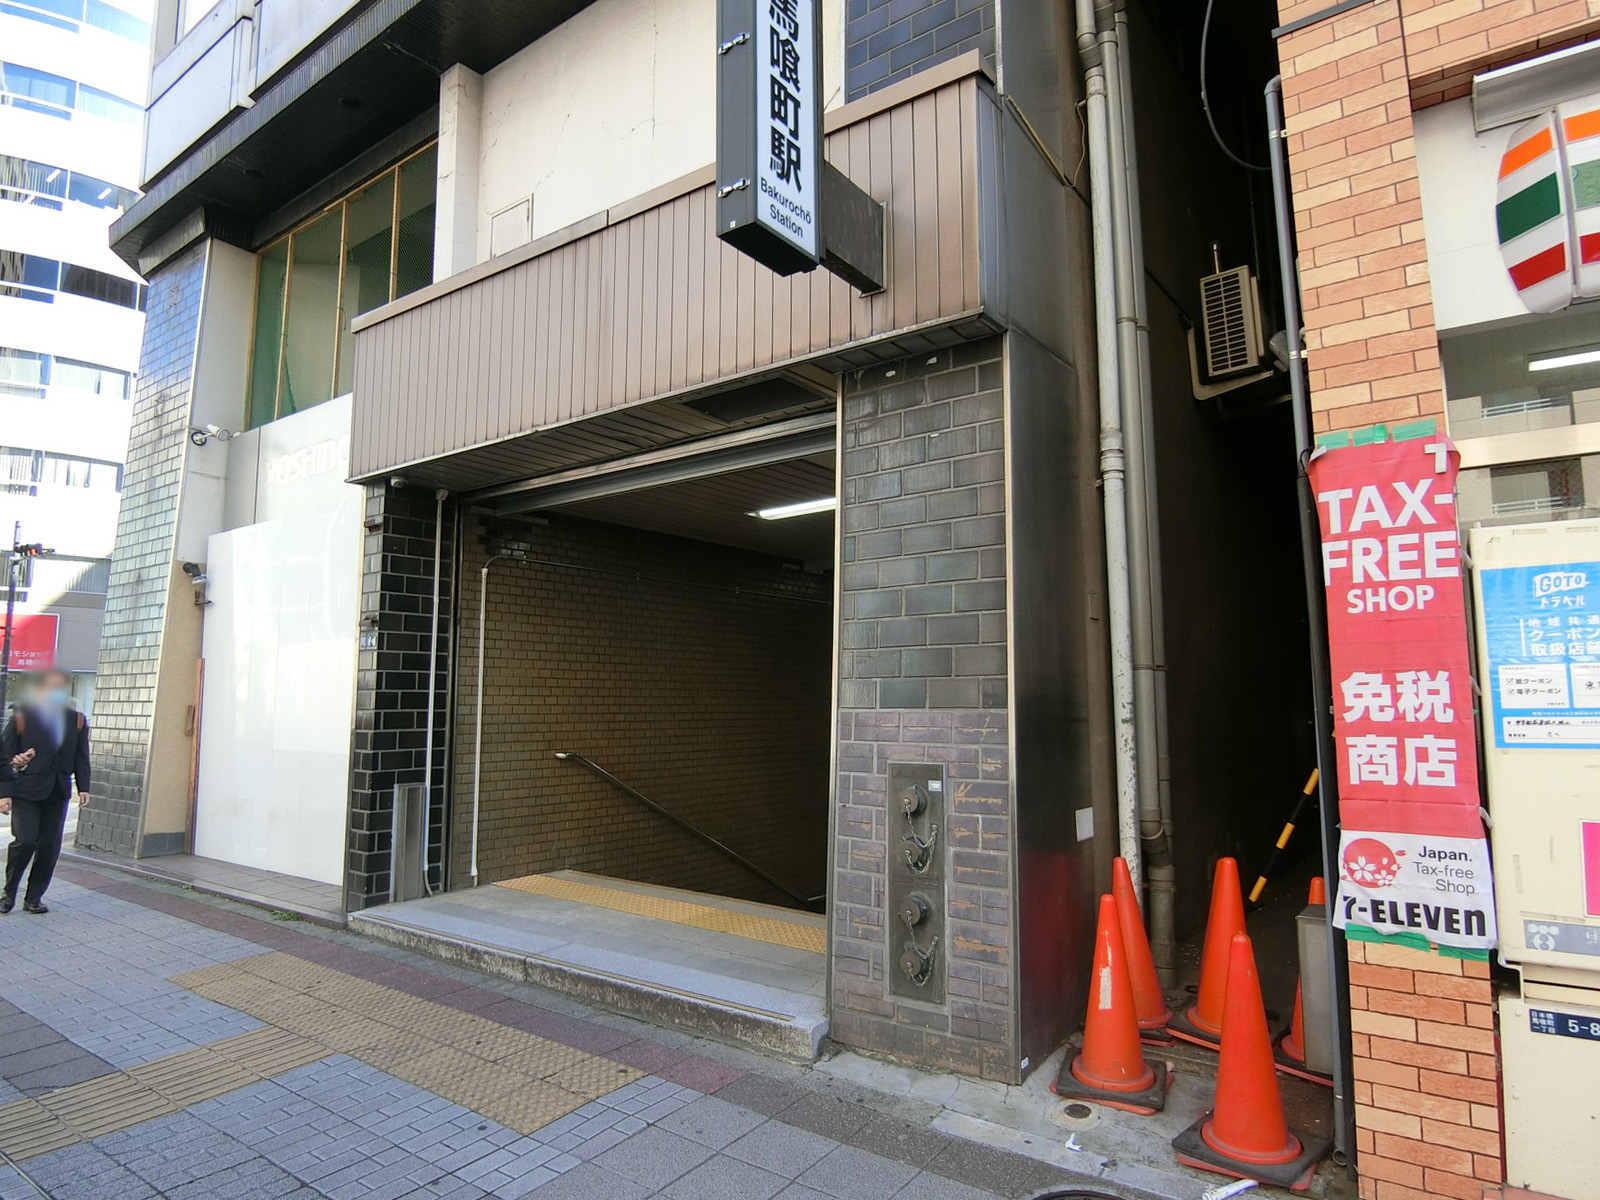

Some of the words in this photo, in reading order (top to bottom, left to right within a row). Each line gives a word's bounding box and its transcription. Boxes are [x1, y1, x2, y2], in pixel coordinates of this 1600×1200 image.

[768, 0, 802, 193] 馬喰町駅
[769, 204, 803, 238] Station
[1318, 478, 1453, 534] TAX-
[1322, 531, 1459, 586] FREE
[1347, 584, 1435, 614] SHOP
[1540, 595, 1586, 609] トラベル
[1529, 627, 1600, 642] クーポン
[1340, 670, 1455, 723] 免税
[1346, 734, 1457, 788] 商店
[1414, 861, 1474, 880] Tax-free
[1436, 878, 1475, 896] Shop
